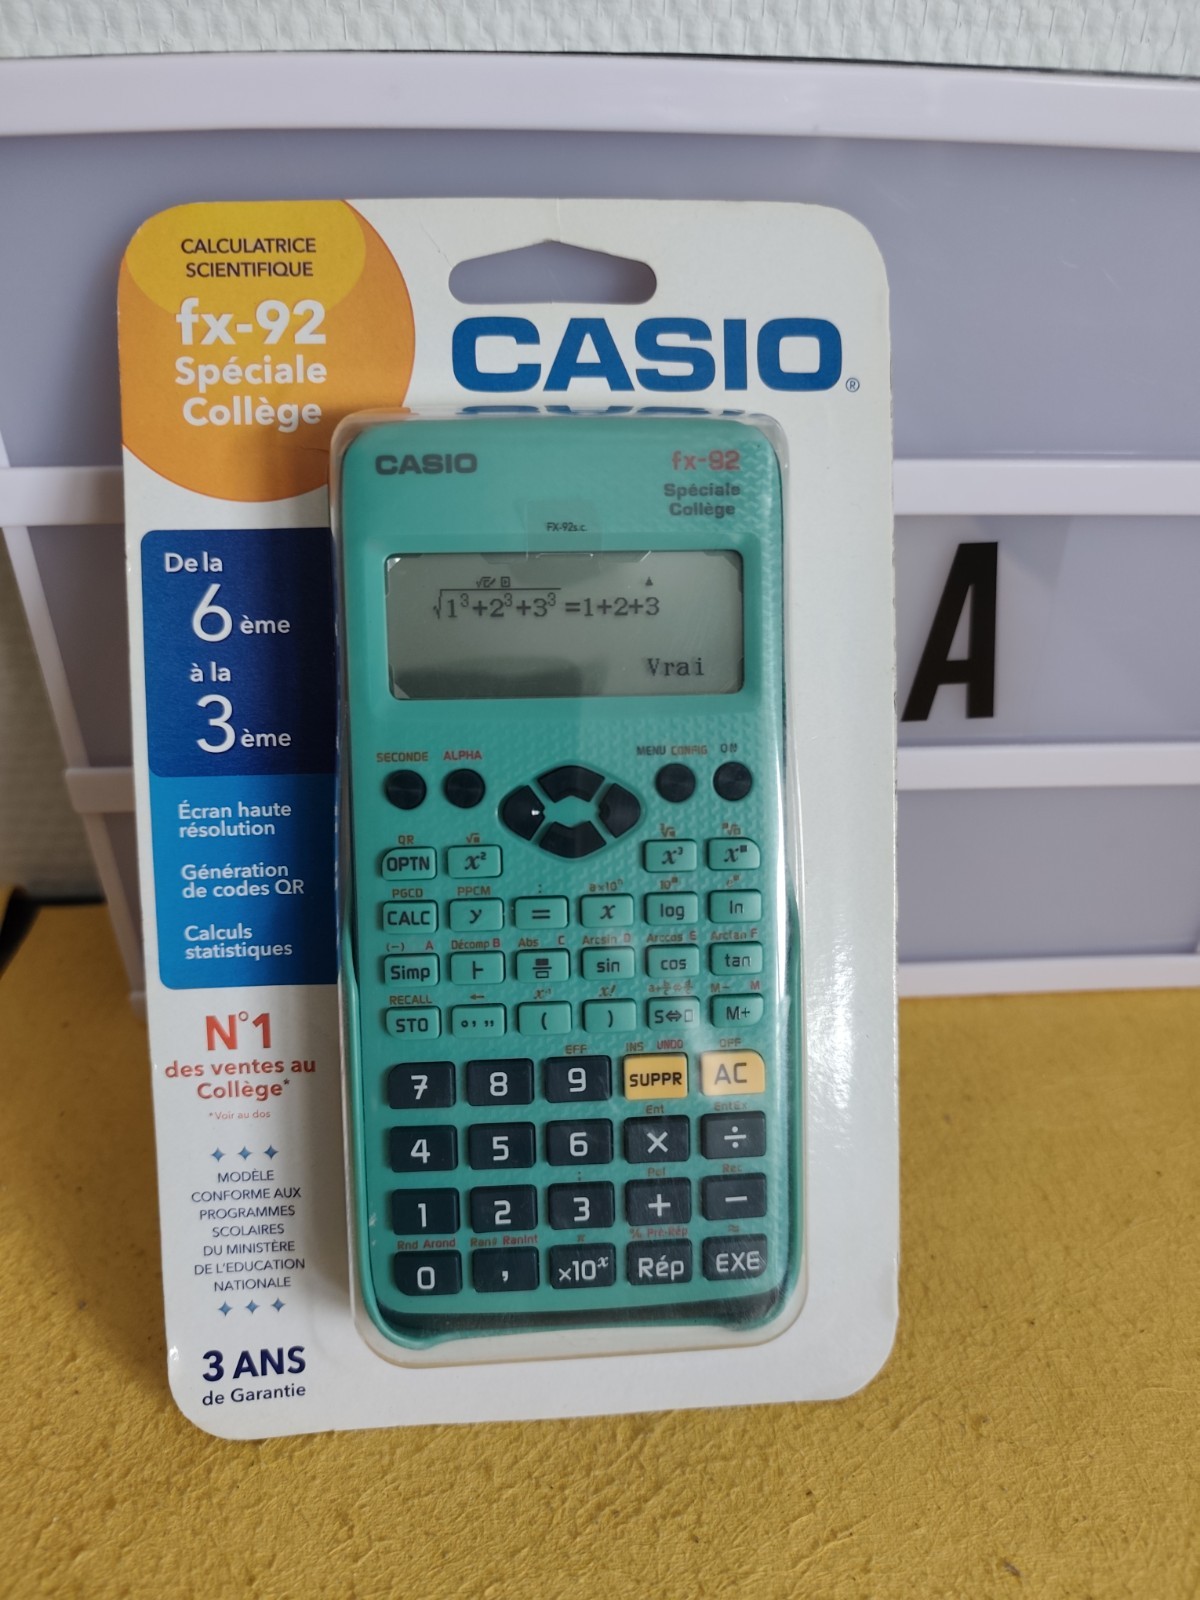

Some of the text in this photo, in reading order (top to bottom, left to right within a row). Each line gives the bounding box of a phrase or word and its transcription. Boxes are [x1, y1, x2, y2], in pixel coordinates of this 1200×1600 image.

[181, 238, 316, 253] CALCULATRICE
[186, 262, 313, 277] SCIENTIFIQUE
[176, 297, 326, 345] fx-92
[452, 316, 842, 392] CASIO
[175, 354, 327, 393] Spéciale
[183, 396, 322, 433] Collège
[375, 454, 477, 475] CASIO
[671, 450, 740, 471] fx-92
[664, 483, 740, 497] Spéciale
[669, 502, 735, 518] Collège
[164, 551, 223, 572] De la
[901, 542, 998, 722] A
[190, 662, 231, 682] à la
[648, 658, 704, 676] Vrai
[377, 752, 428, 762] SECONDE
[444, 751, 482, 760] ALPHA
[637, 745, 707, 755] MENU CONFIG
[178, 800, 291, 819] Écran haute
[180, 820, 275, 838] résolution
[398, 835, 414, 845] QR
[181, 862, 288, 880] Génération
[387, 857, 429, 871] OPTN
[182, 879, 304, 898] de codes QR
[393, 888, 423, 898] PGCD
[457, 886, 491, 896] PPCM
[600, 905, 615, 919] x
[661, 904, 684, 920] log
[730, 900, 743, 914] ln
[388, 911, 430, 925] CALC
[470, 910, 482, 923] y
[184, 923, 252, 941] Calculs
[647, 931, 696, 943] Arccos E
[426, 941, 433, 950] A
[452, 938, 500, 950] Décomp B
[519, 936, 565, 947] Abs C
[583, 935, 617, 945] Arcsin
[185, 942, 292, 961] statistiques
[597, 959, 619, 973] sin
[661, 959, 686, 970] cos
[725, 954, 751, 967] tan
[391, 966, 430, 981] Simp
[750, 981, 760, 989] M
[390, 995, 432, 1005] RECALL
[726, 1006, 750, 1020] M+
[396, 1018, 428, 1032] STO
[565, 1045, 587, 1054] EFF
[626, 1040, 683, 1051] INS UNDO
[720, 1038, 741, 1047] OFF
[165, 1059, 315, 1078] des ventes au
[714, 1063, 747, 1085] AC
[411, 1075, 428, 1099] 7
[490, 1072, 508, 1096] 8
[568, 1068, 586, 1092] 9
[630, 1072, 682, 1087] SUPPR
[238, 1111, 249, 1119] au
[253, 1110, 270, 1118] dos
[646, 1105, 664, 1114] Ent
[411, 1139, 430, 1163] 4
[493, 1136, 509, 1160] 5
[570, 1132, 588, 1156] 6
[218, 1169, 274, 1183] MODÈLE
[191, 1187, 301, 1203] CONFORME AUX
[200, 1206, 295, 1220] PROGRAMMES
[418, 1203, 426, 1227] 1
[495, 1200, 511, 1225] 2
[574, 1197, 590, 1221] 3
[212, 1224, 284, 1237] SCOLAIRES
[203, 1239, 295, 1256] DU MINISTÈRE
[397, 1239, 455, 1250] Rnd Arond
[194, 1259, 305, 1275] DE L'EDUCATION
[639, 1255, 684, 1280] Rép
[716, 1251, 759, 1272] EXE
[214, 1277, 291, 1292] NATIONALE
[417, 1267, 435, 1289] 0
[202, 1346, 306, 1382] 3 ANS
[202, 1383, 306, 1405] de Garantie
